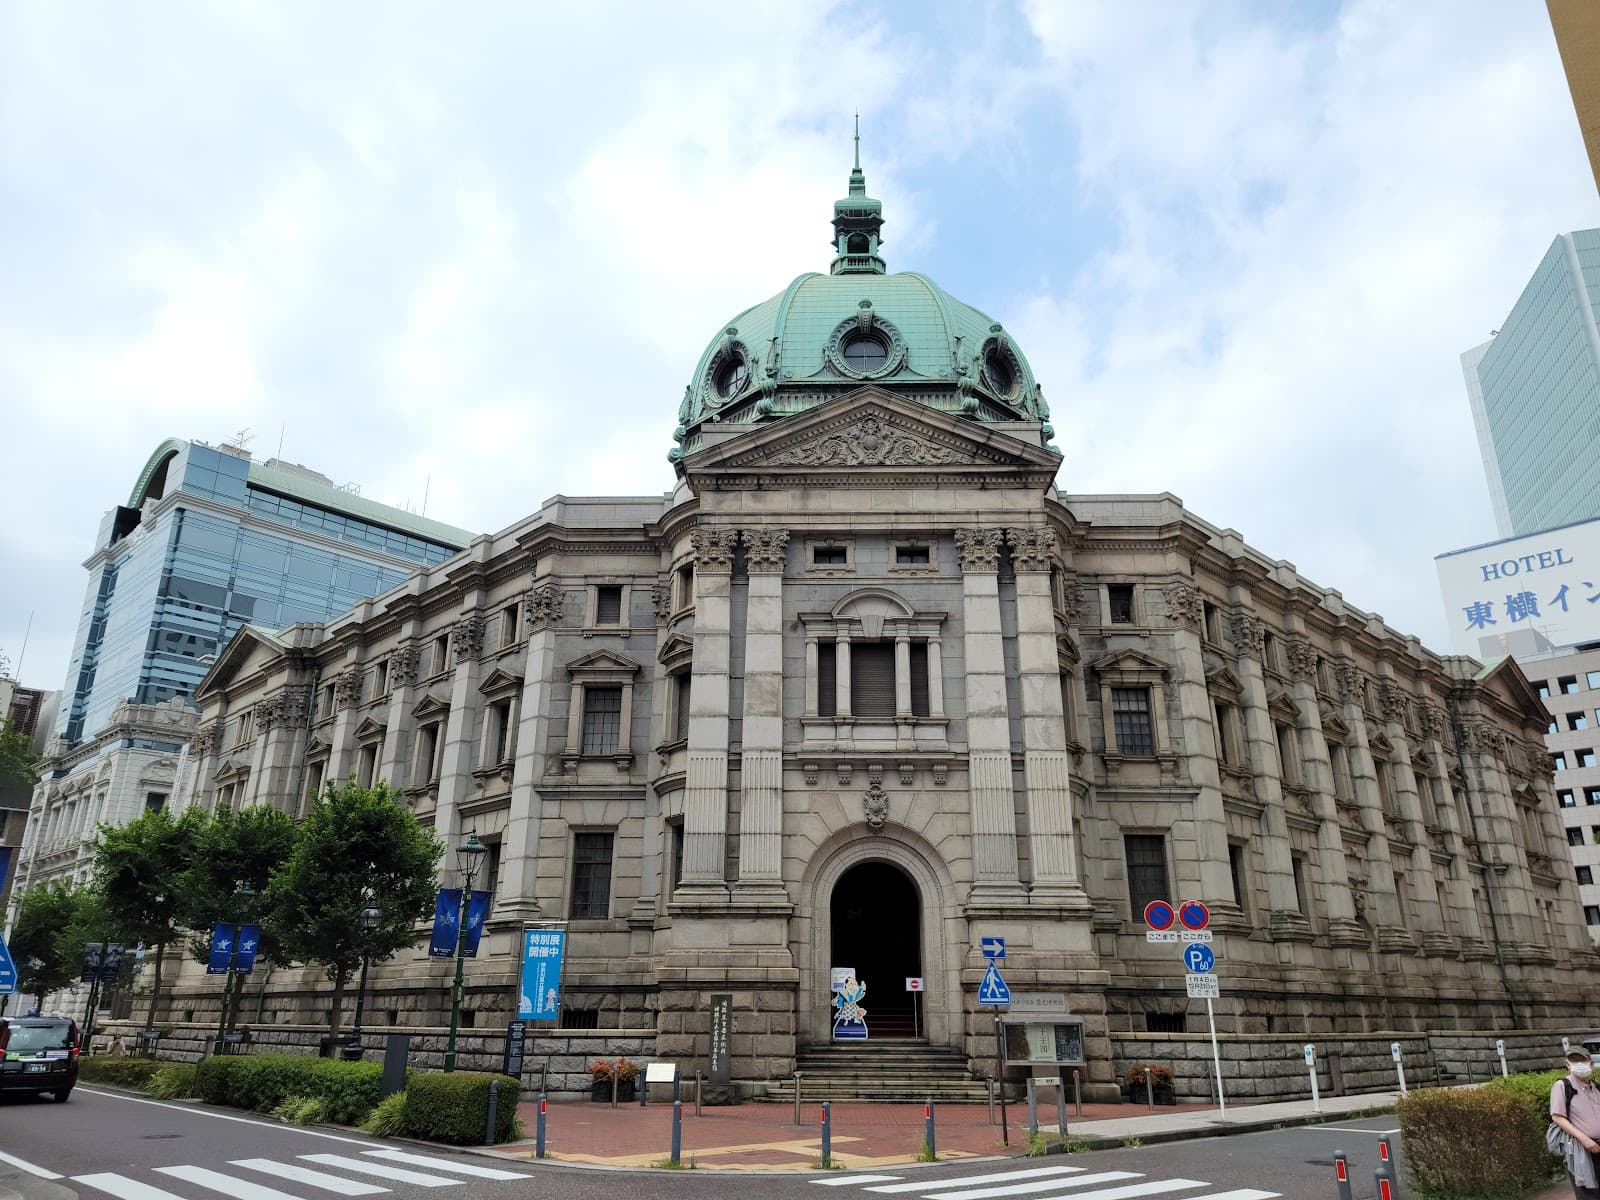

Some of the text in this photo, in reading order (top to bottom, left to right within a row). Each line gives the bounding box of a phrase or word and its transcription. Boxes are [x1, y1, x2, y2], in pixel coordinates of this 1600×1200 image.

[1480, 548, 1573, 581] HOTEL
[1462, 581, 1600, 631] 東横イン
[530, 934, 561, 946] 特別展
[528, 946, 559, 958] 開催中
